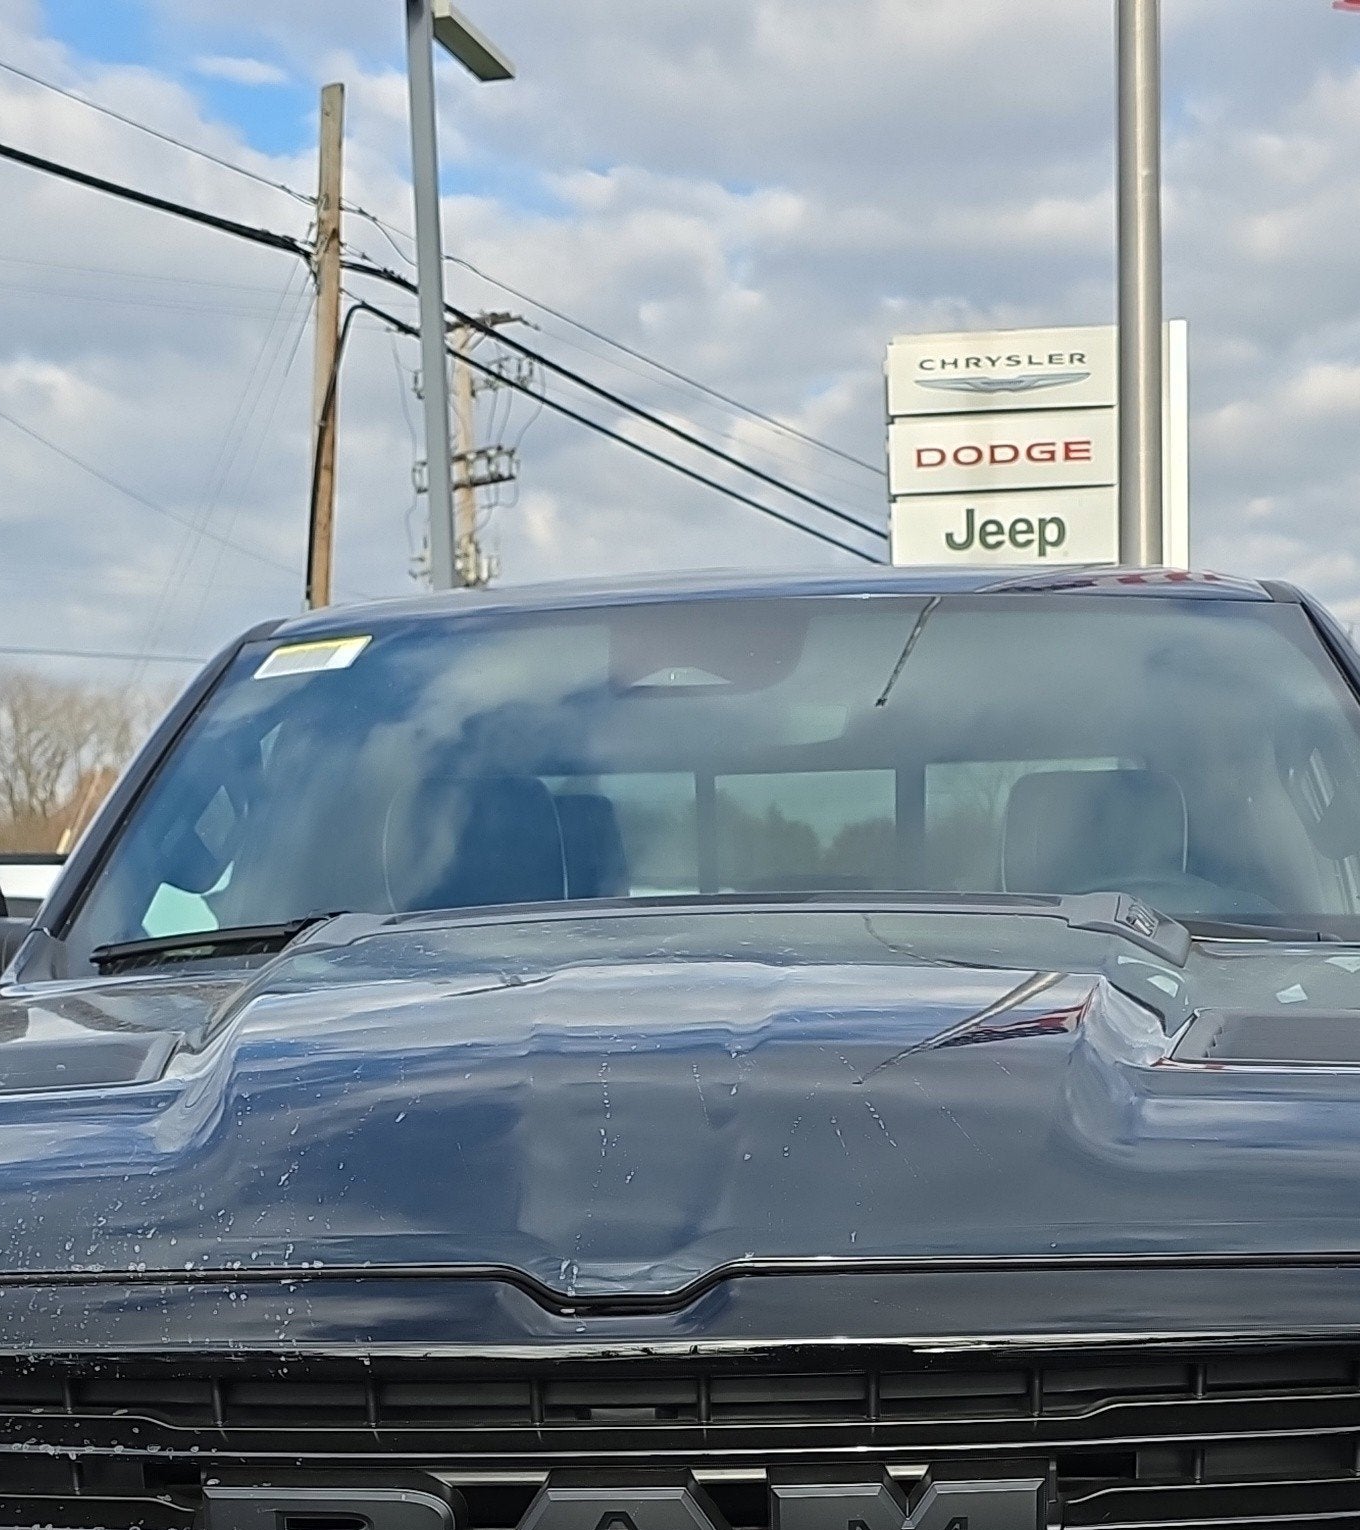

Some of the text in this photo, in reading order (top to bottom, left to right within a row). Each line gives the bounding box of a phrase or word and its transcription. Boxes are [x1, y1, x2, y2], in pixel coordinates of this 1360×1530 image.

[918, 352, 1087, 371] CHRYSLER
[915, 440, 1092, 468] DODGE
[944, 507, 1067, 558] Jeep
